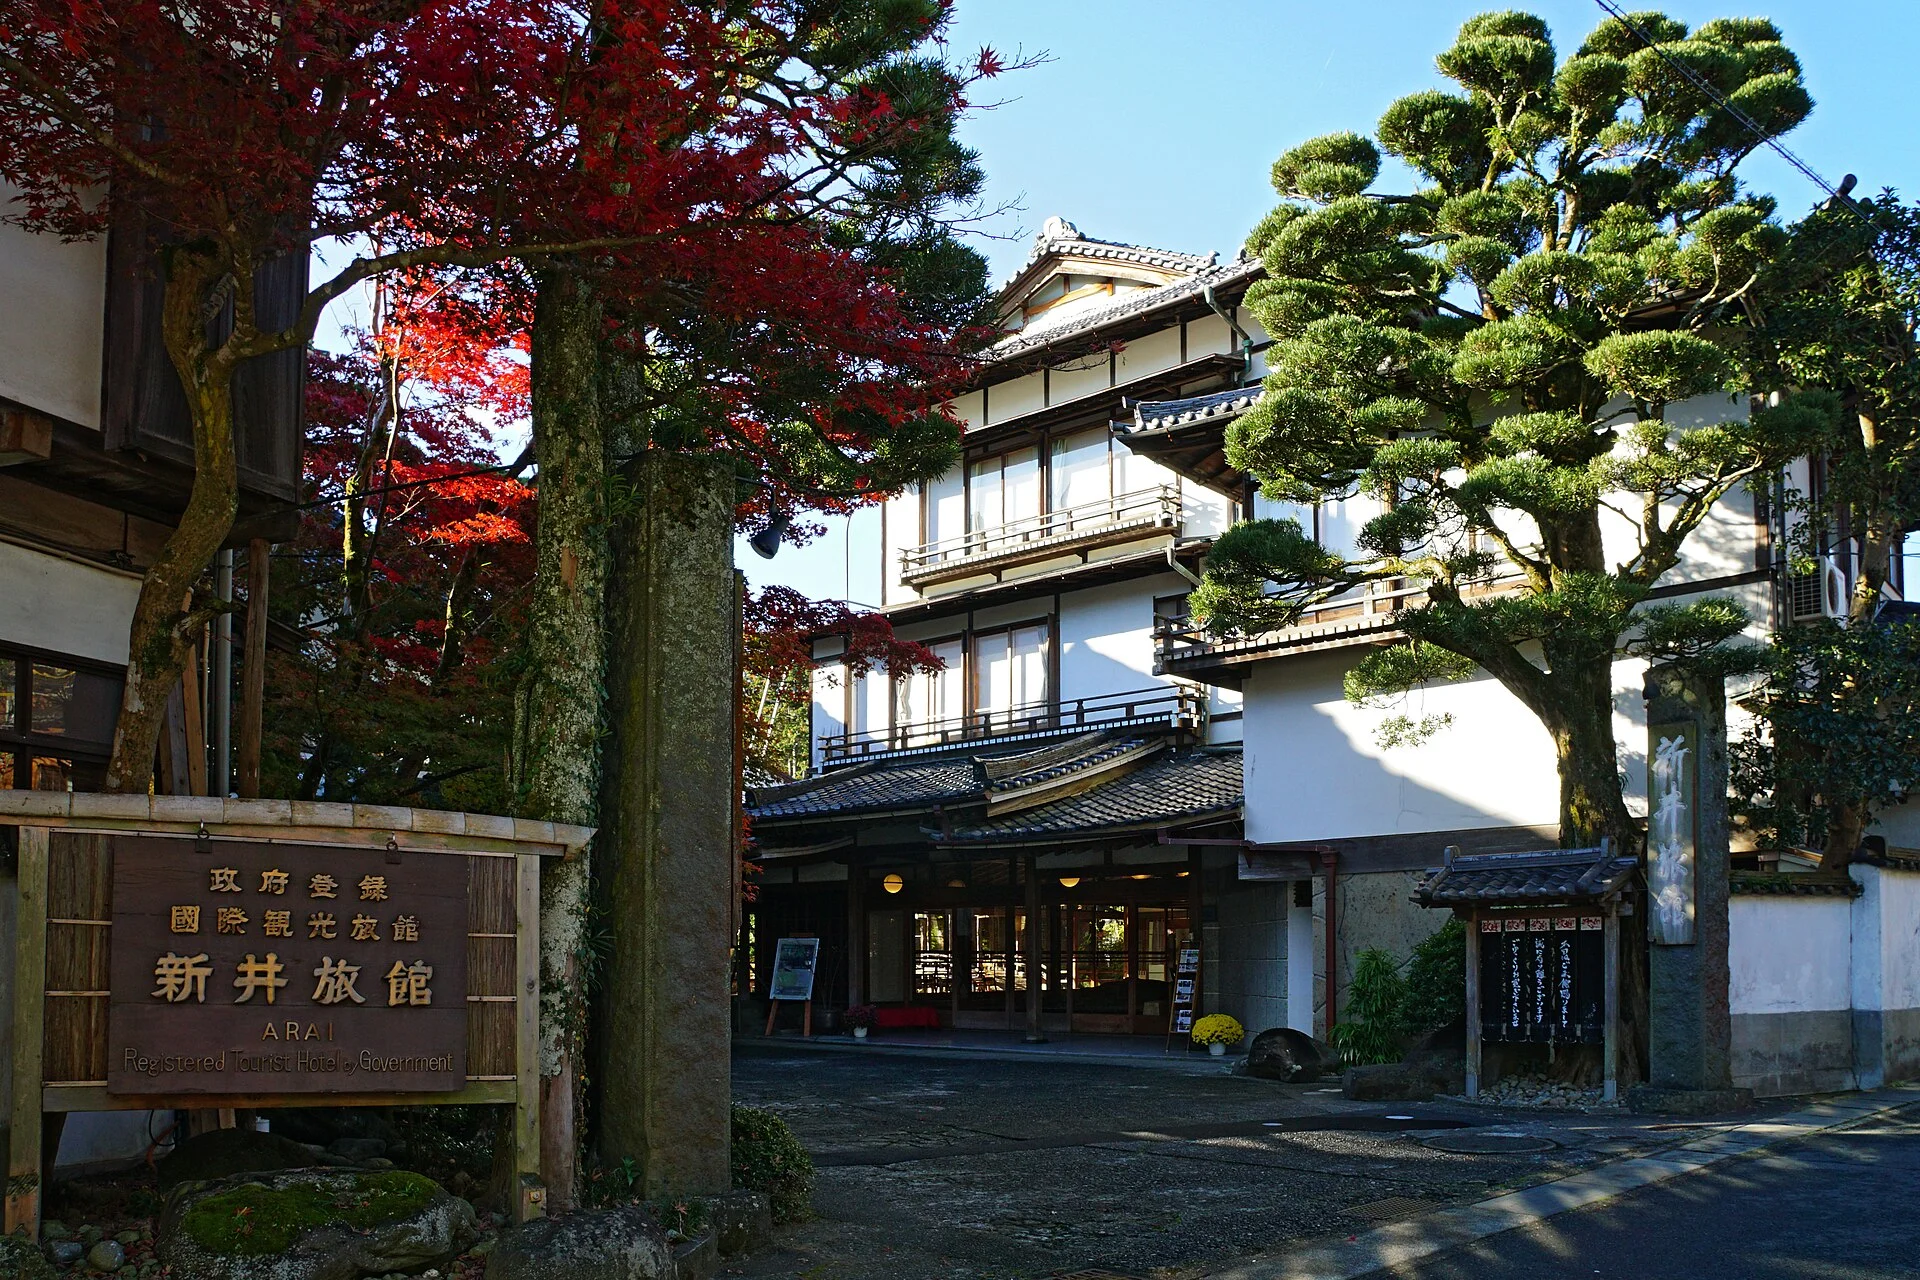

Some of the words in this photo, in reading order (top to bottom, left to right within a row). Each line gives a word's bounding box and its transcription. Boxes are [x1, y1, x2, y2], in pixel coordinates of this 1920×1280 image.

[1651, 734, 1692, 926] 新井旅館
[209, 866, 389, 902] 政府登録
[170, 904, 420, 942] 國際観光旅館
[150, 952, 433, 1007] 新井旅館
[261, 1020, 334, 1041] ARAI
[124, 1047, 226, 1076] Registered
[230, 1048, 290, 1072] Tourist
[297, 1049, 341, 1072] Hotel
[359, 1049, 453, 1072] Government
